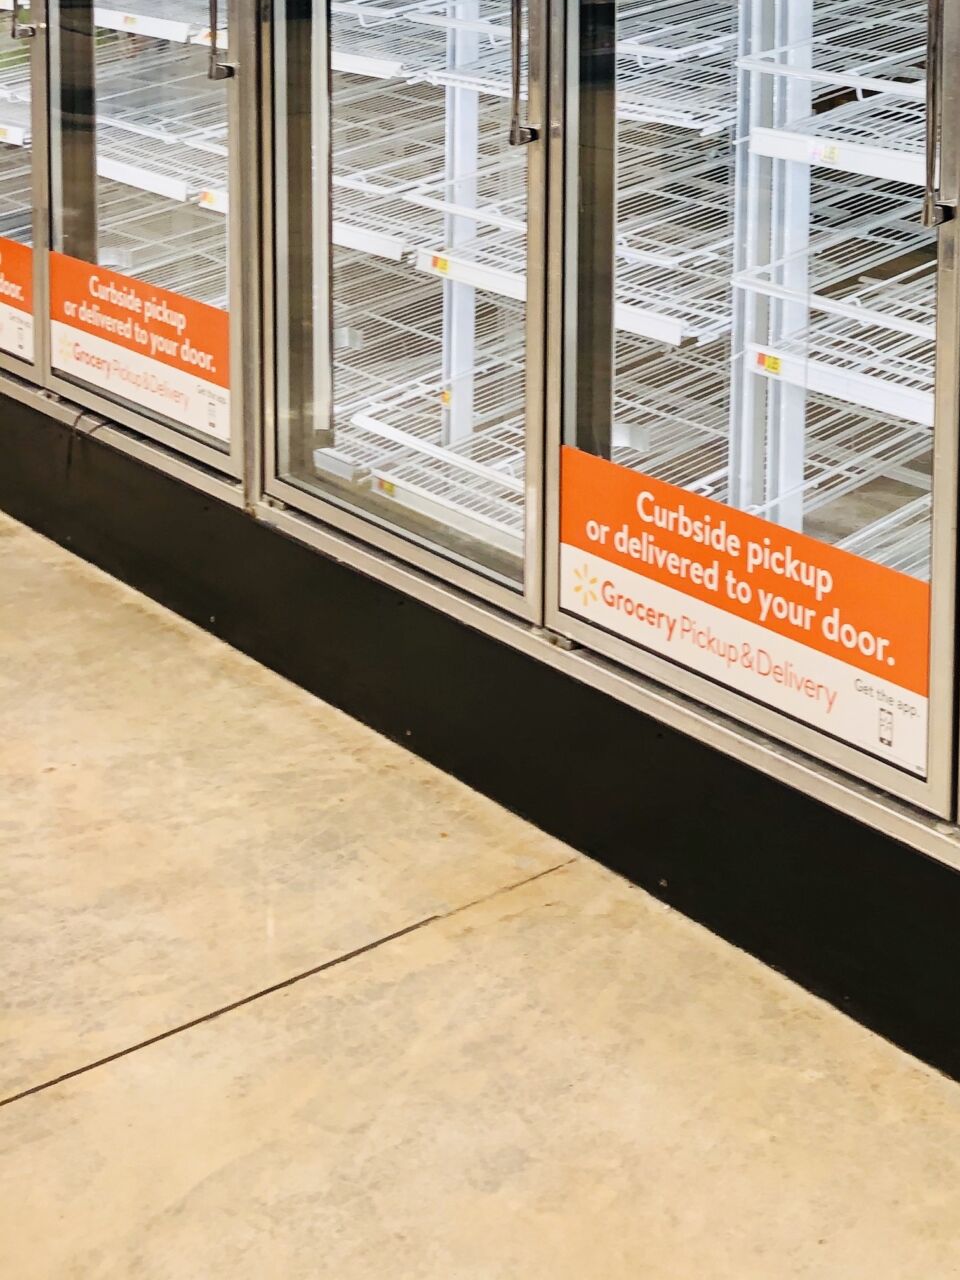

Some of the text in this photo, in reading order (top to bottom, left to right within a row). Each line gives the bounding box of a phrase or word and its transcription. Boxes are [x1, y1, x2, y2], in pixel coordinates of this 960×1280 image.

[64, 300, 217, 373] or delivered to your door.
[89, 275, 187, 336] Curbside pickup
[73, 341, 112, 380] Grocery
[636, 491, 833, 601] Curbside pickup
[585, 520, 896, 666] or delivered to your door.
[600, 580, 677, 642] Grocery
[855, 678, 874, 698] Get
[876, 689, 894, 706] the
